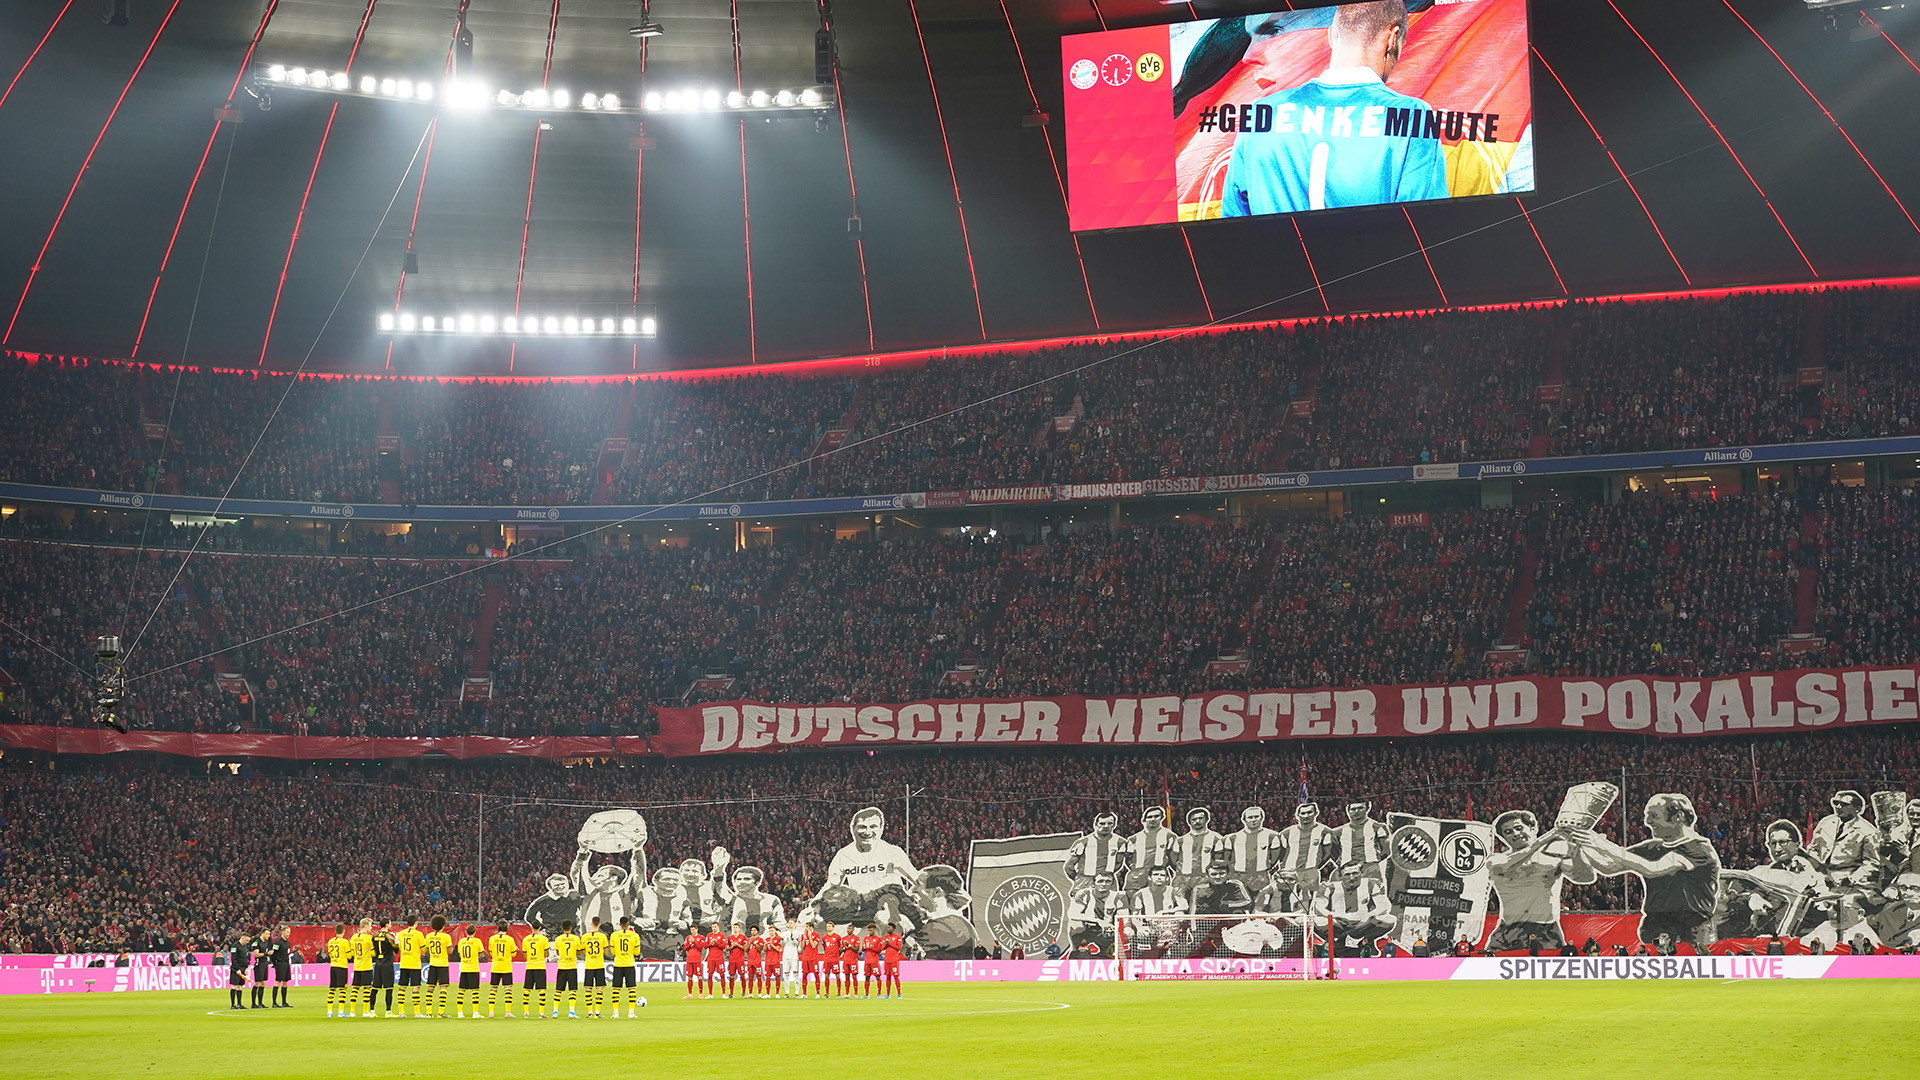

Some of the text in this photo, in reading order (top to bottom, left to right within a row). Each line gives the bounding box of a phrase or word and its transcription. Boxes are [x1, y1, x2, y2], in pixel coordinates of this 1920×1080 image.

[1140, 56, 1160, 73] BVB
[1199, 103, 1499, 143] #GEDENKEMINUTE
[864, 357, 881, 367] 318
[1704, 450, 1737, 462] Allianz
[1479, 464, 1512, 474] Allianz
[1143, 473, 1266, 493] GIESSEN BULLS
[1264, 477, 1296, 487] Allianz
[970, 486, 1051, 502] WALDKIRCHEN
[1073, 482, 1142, 498] HAINSACKER
[100, 493, 130, 505] Allianz
[862, 497, 892, 508] Allianz
[310, 505, 341, 517] Allianz
[516, 509, 547, 519] Allianz
[699, 505, 729, 516] Allianz
[700, 669, 1920, 752] DEUTSCHER MEISTER UND POKALSIE
[845, 863, 886, 875] adidas
[1456, 857, 1472, 868] 04
[1011, 879, 1058, 902] BAYERN
[1409, 879, 1460, 893] DEUTSCHES
[1397, 913, 1465, 929] FRANKFURT
[403, 937, 412, 952] 15
[993, 923, 1049, 952] MUNHEN
[329, 944, 340, 958] 23
[429, 940, 442, 955] 28
[462, 945, 472, 959] 10
[496, 943, 506, 957] 14
[530, 942, 537, 956] 5
[565, 942, 571, 956] 7
[587, 940, 600, 955] 33
[619, 938, 629, 952] 16
[1069, 958, 1281, 981] MAGENTA SPORT
[1499, 958, 1784, 980] SPITZENFUSSBALL LIVE
[134, 966, 212, 991] MAGENTA
